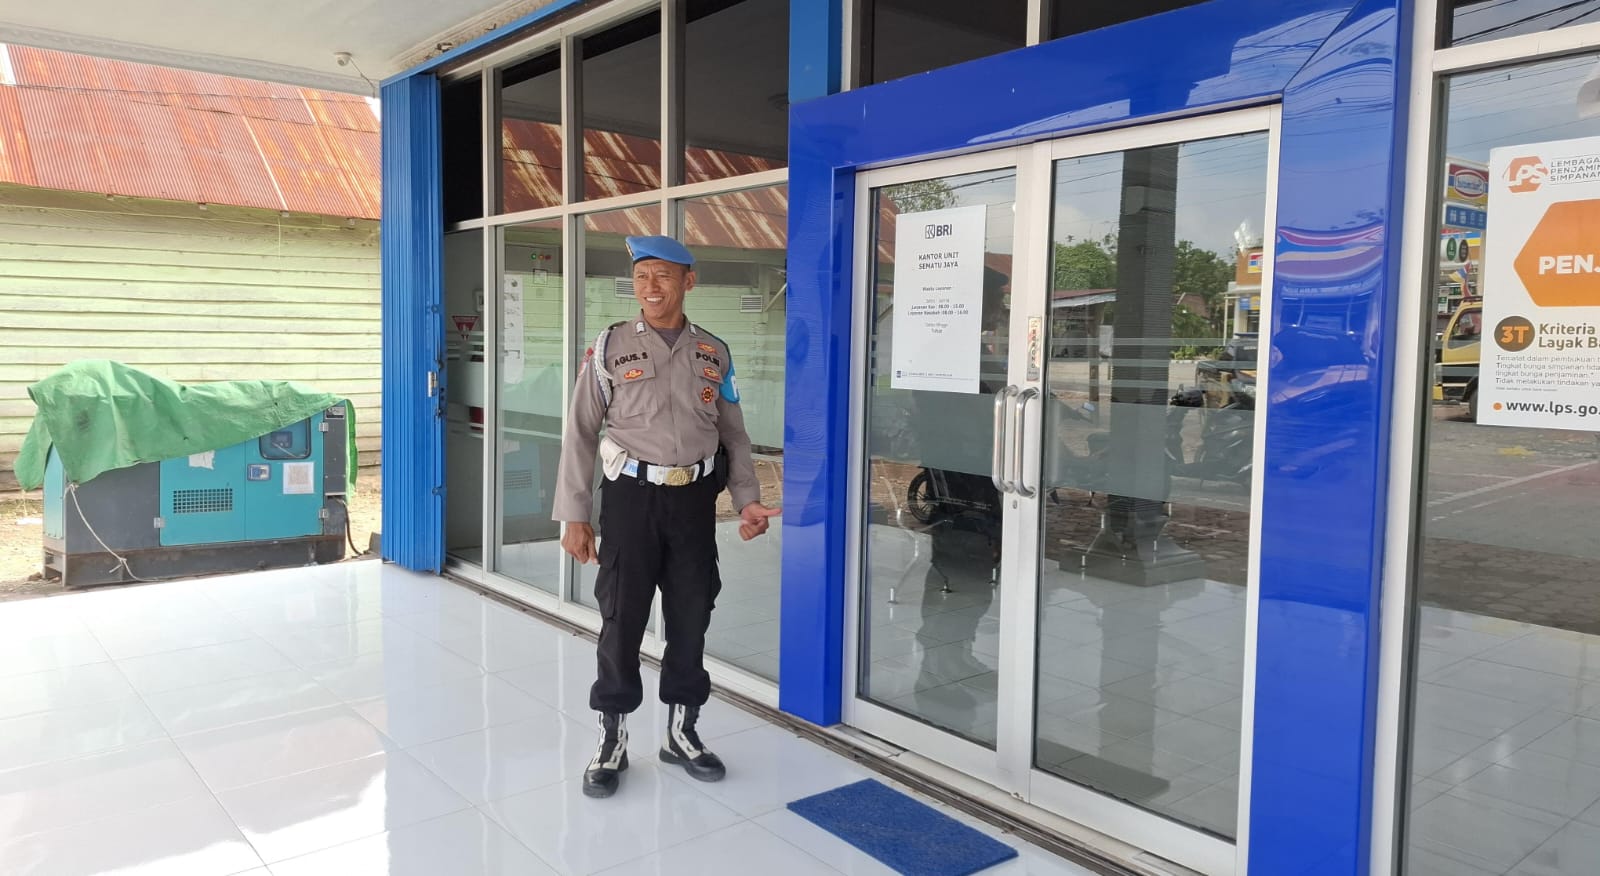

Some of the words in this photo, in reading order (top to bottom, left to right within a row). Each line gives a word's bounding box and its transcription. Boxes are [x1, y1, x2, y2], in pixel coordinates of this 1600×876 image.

[1551, 157, 1600, 167] LEMBAGA
[936, 224, 952, 236] BRI
[944, 251, 959, 259] UNIT
[1538, 254, 1600, 275] PEN
[1500, 326, 1529, 344] 3T
[1539, 323, 1595, 335] Kriteria
[1538, 337, 1583, 351] Layak
[642, 352, 648, 360] S
[1520, 370, 1543, 378] bunga
